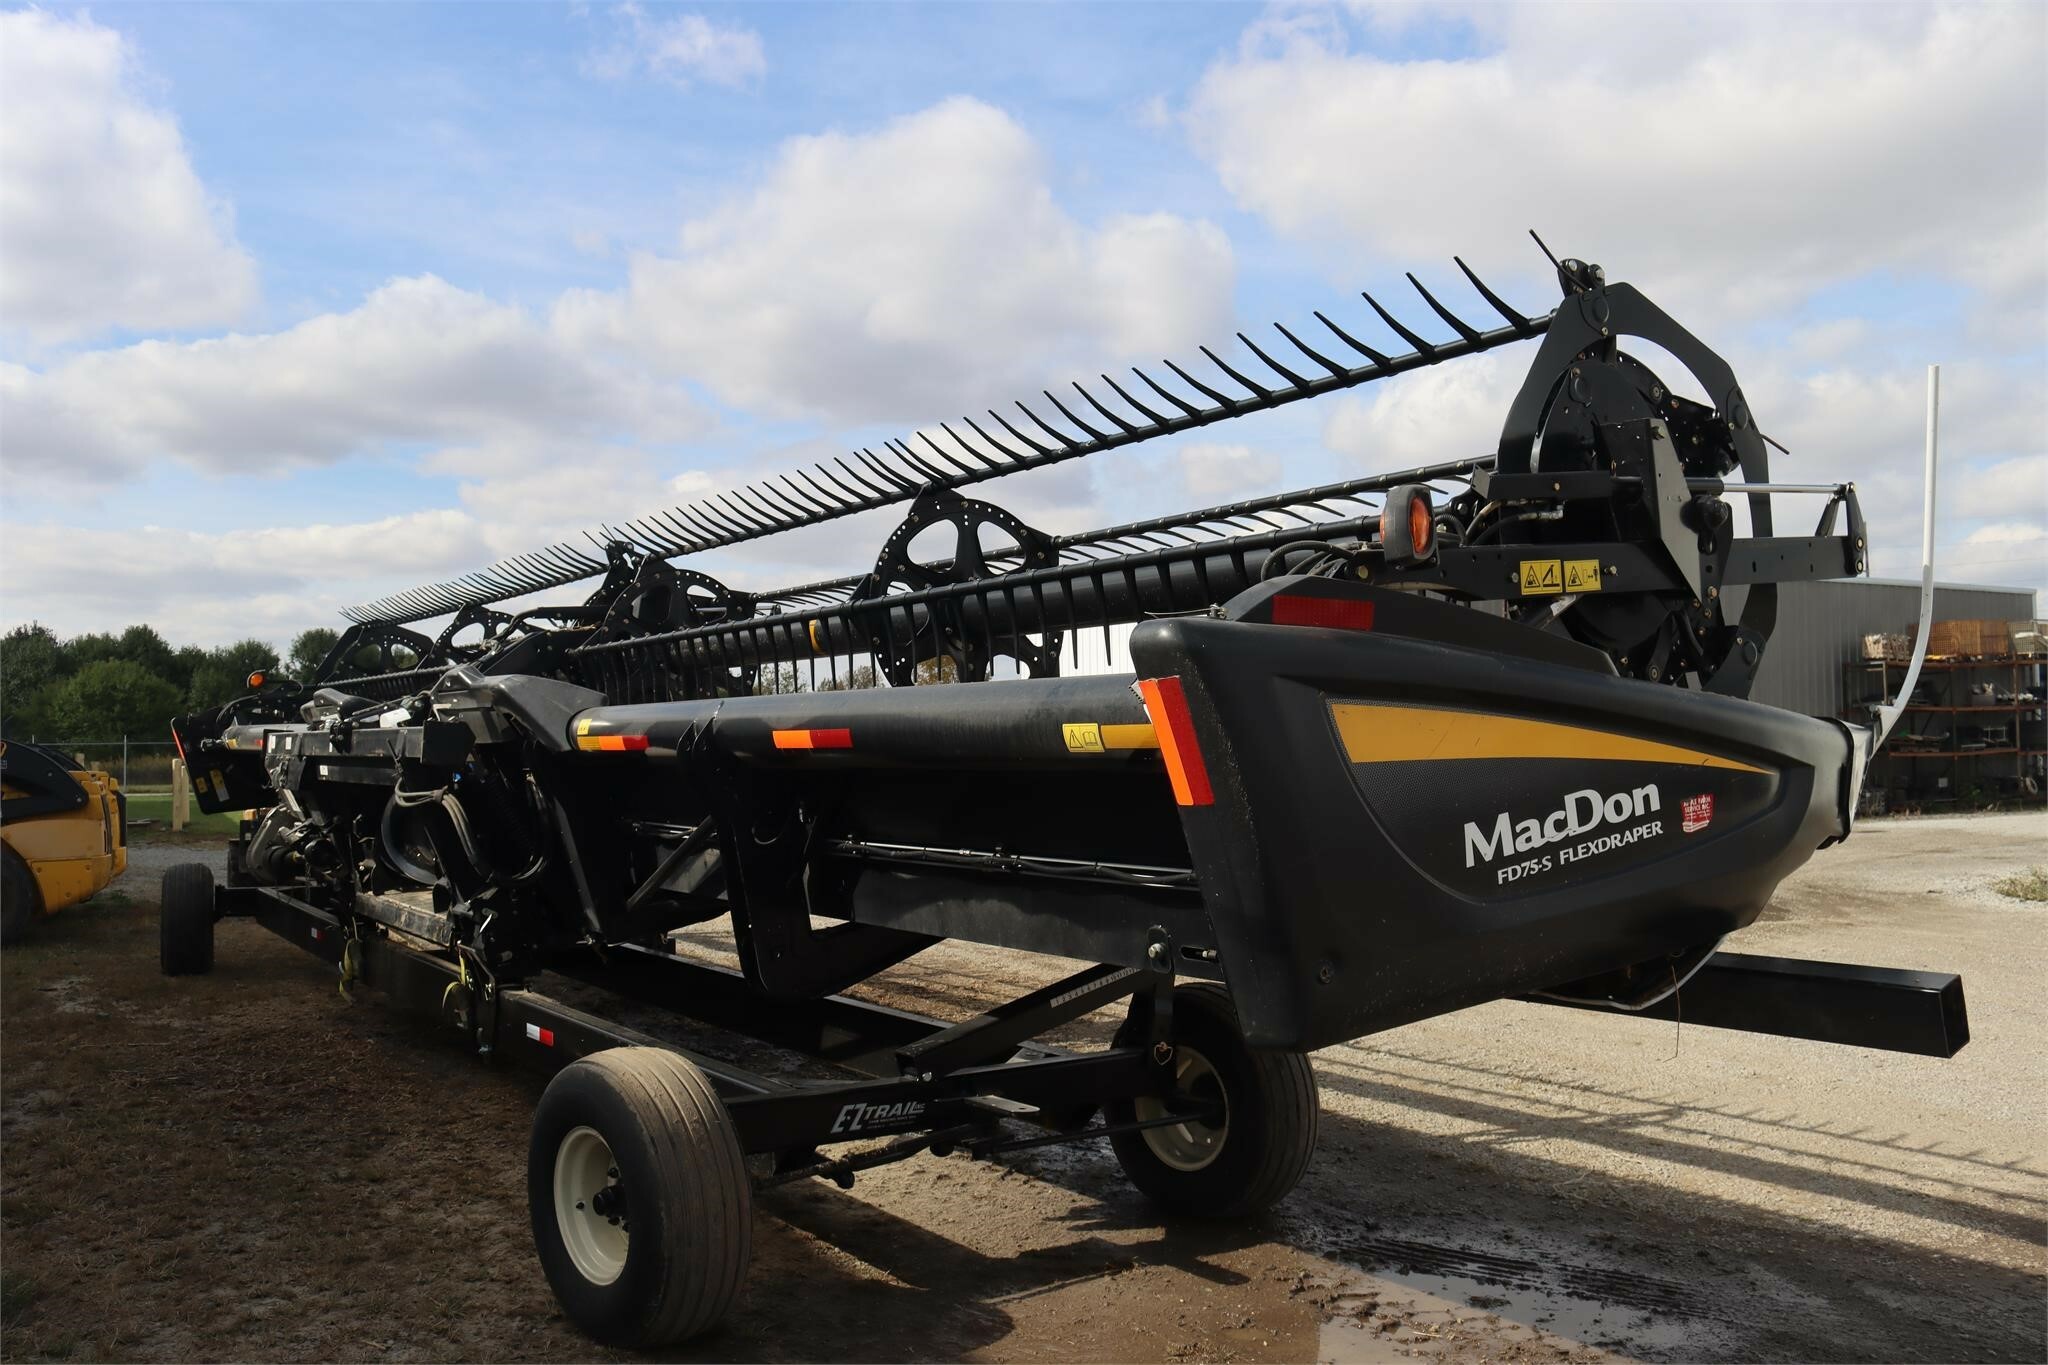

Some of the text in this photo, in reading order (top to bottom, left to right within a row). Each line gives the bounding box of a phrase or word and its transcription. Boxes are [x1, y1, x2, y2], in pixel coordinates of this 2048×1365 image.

[1464, 783, 1662, 868] MacDon
[1497, 821, 1663, 885] FD75-S FLEXDRAPER
[864, 1101, 925, 1120] TRAIL
